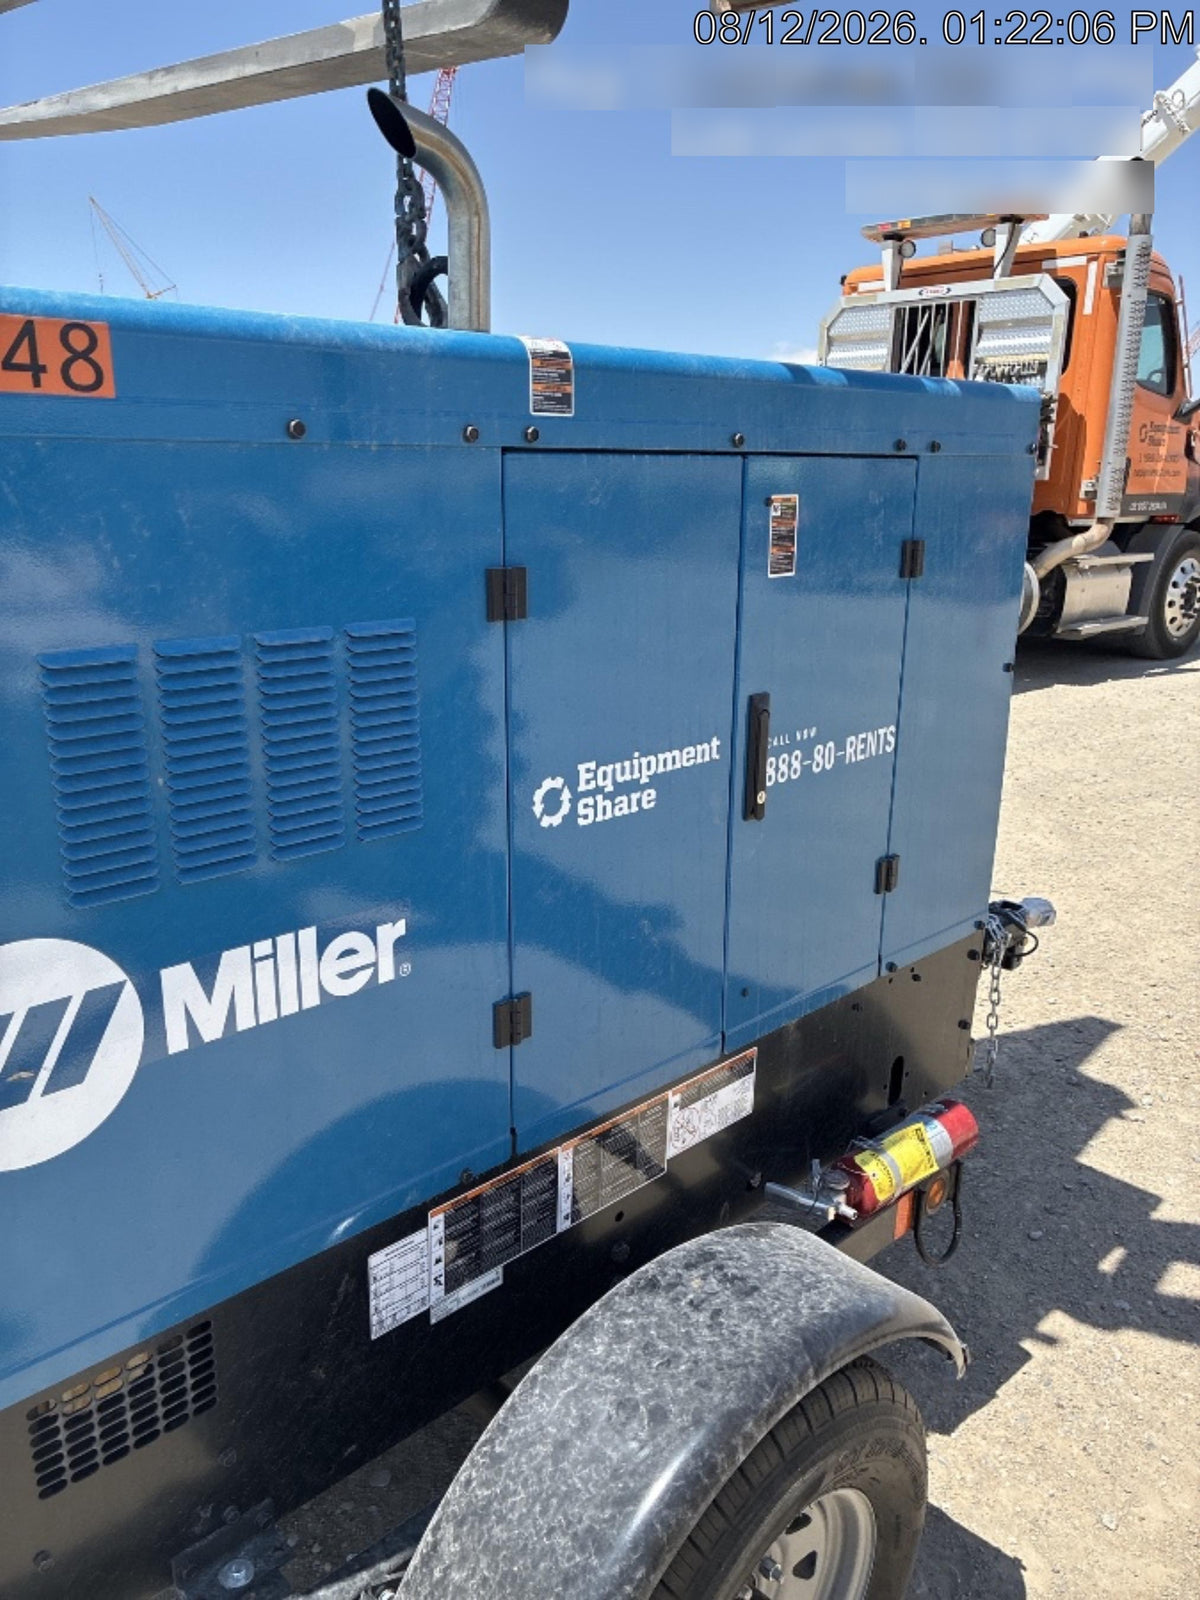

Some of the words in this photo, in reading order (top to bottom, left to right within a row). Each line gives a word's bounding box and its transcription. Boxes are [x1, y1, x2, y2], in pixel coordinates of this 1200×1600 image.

[1, 319, 104, 393] 48
[577, 736, 721, 793] Equipment
[577, 788, 657, 826] Share
[160, 918, 407, 1055] Miller
